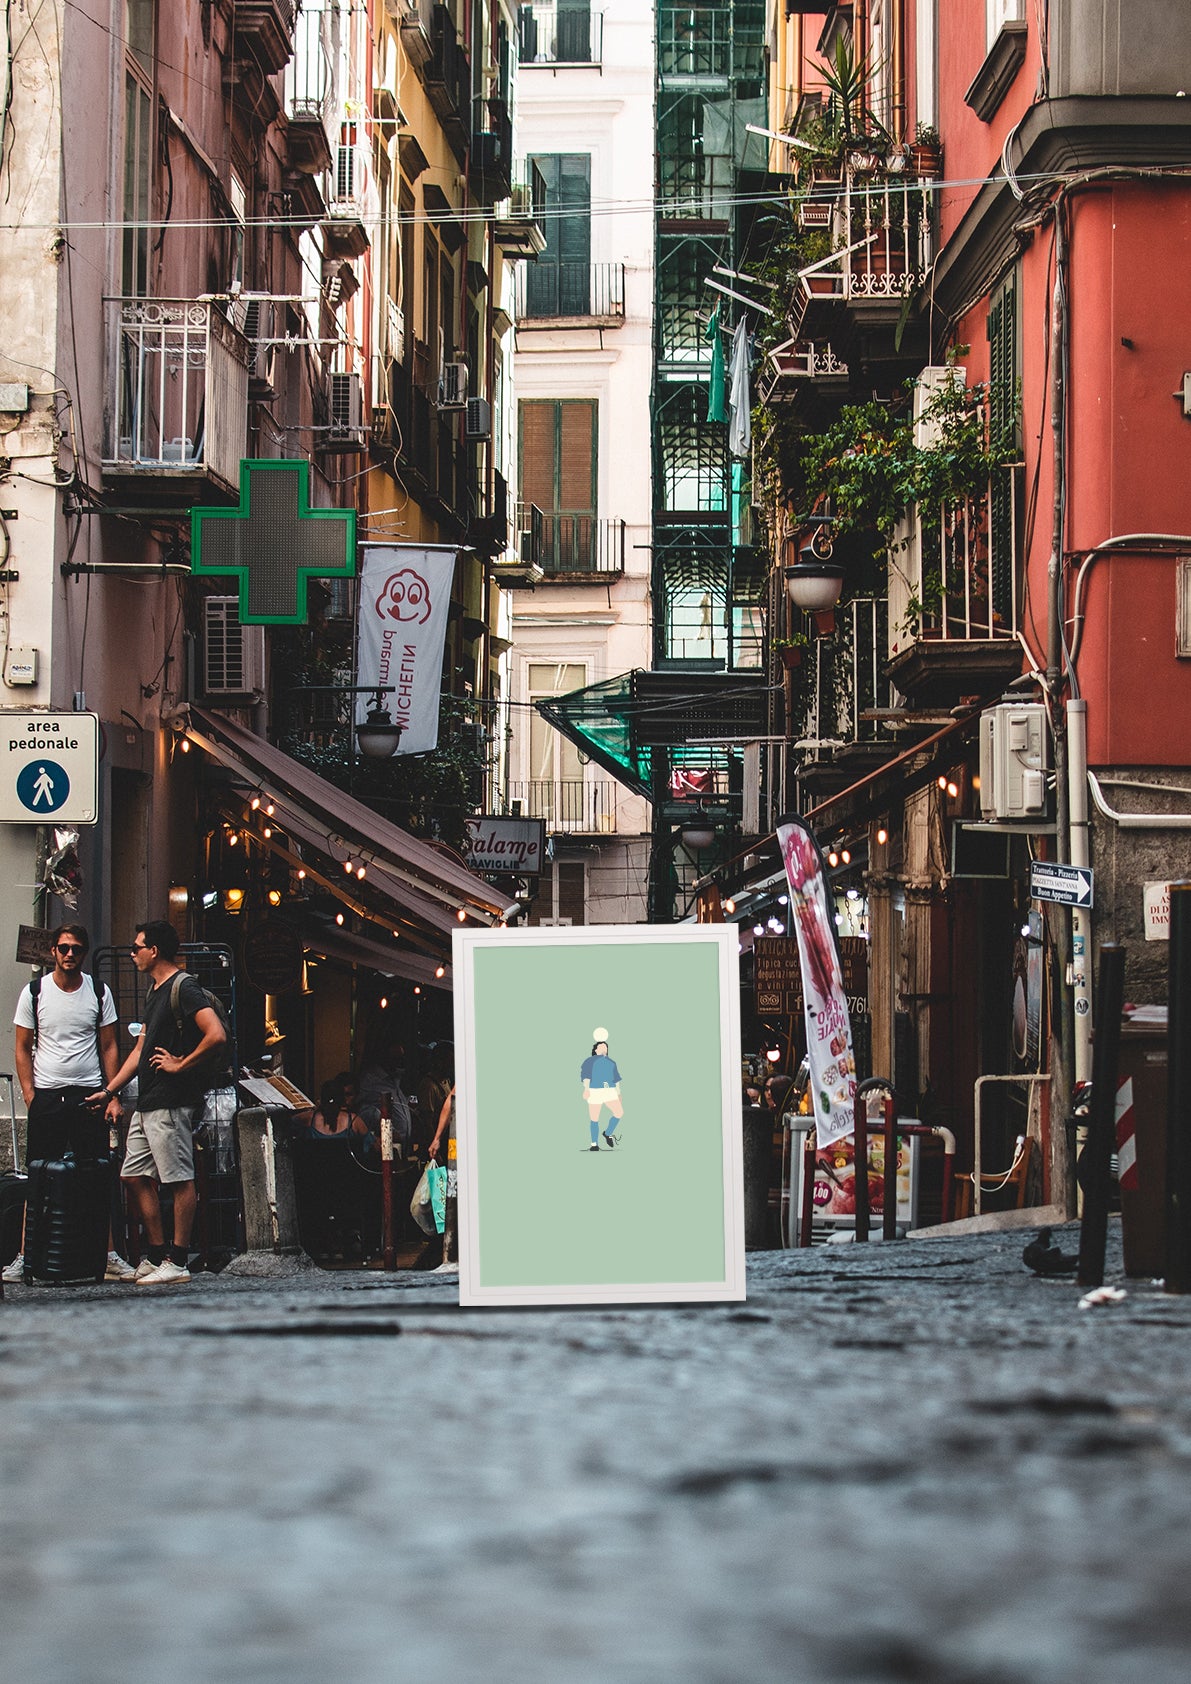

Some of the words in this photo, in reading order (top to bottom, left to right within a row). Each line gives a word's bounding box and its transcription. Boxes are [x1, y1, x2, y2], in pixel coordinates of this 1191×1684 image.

[27, 722, 60, 732] area
[9, 737, 79, 751] pedonale
[1058, 869, 1078, 879] Pizzeria
[1037, 888, 1051, 897] Buon
